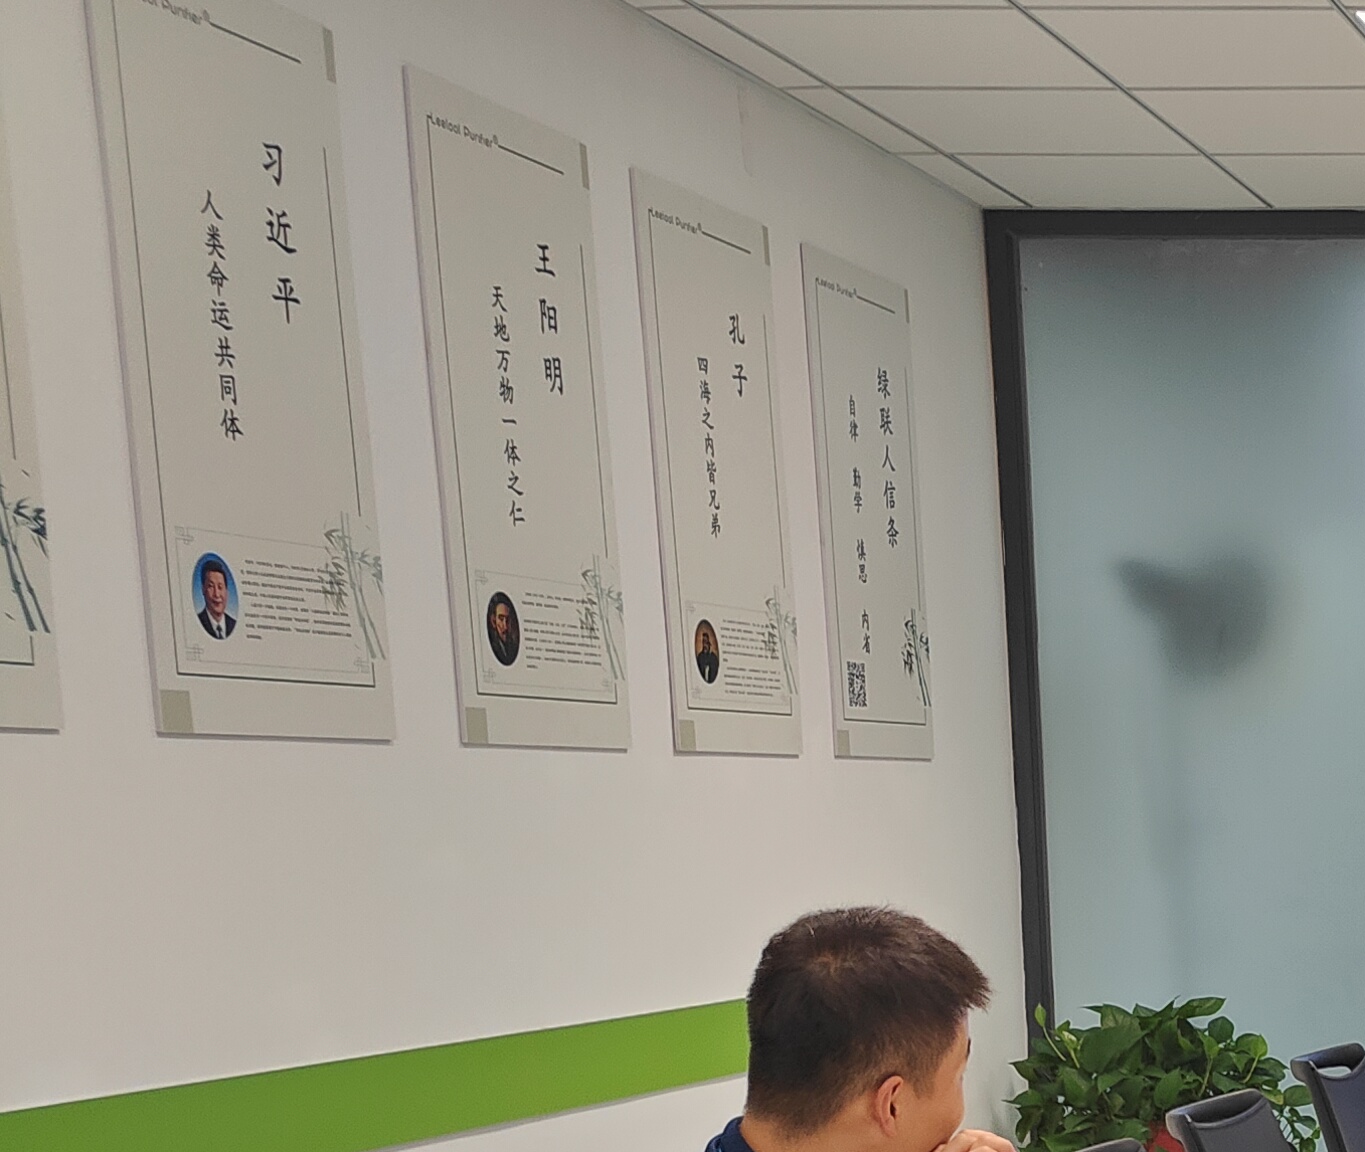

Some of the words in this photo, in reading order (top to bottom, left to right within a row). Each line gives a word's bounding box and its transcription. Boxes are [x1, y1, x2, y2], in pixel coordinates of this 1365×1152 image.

[200, 189, 244, 441] 人类命运共同体
[262, 142, 301, 324] 习近平
[535, 244, 563, 395] 王阳明
[729, 313, 748, 397] 孔子
[491, 286, 526, 526] 天地万物一体之仁
[697, 357, 721, 539] 四海之内皆兄弟
[849, 395, 859, 442] 自律
[876, 367, 900, 548] 绿联人信条
[852, 467, 864, 513] 勤学
[861, 610, 872, 654] 内省
